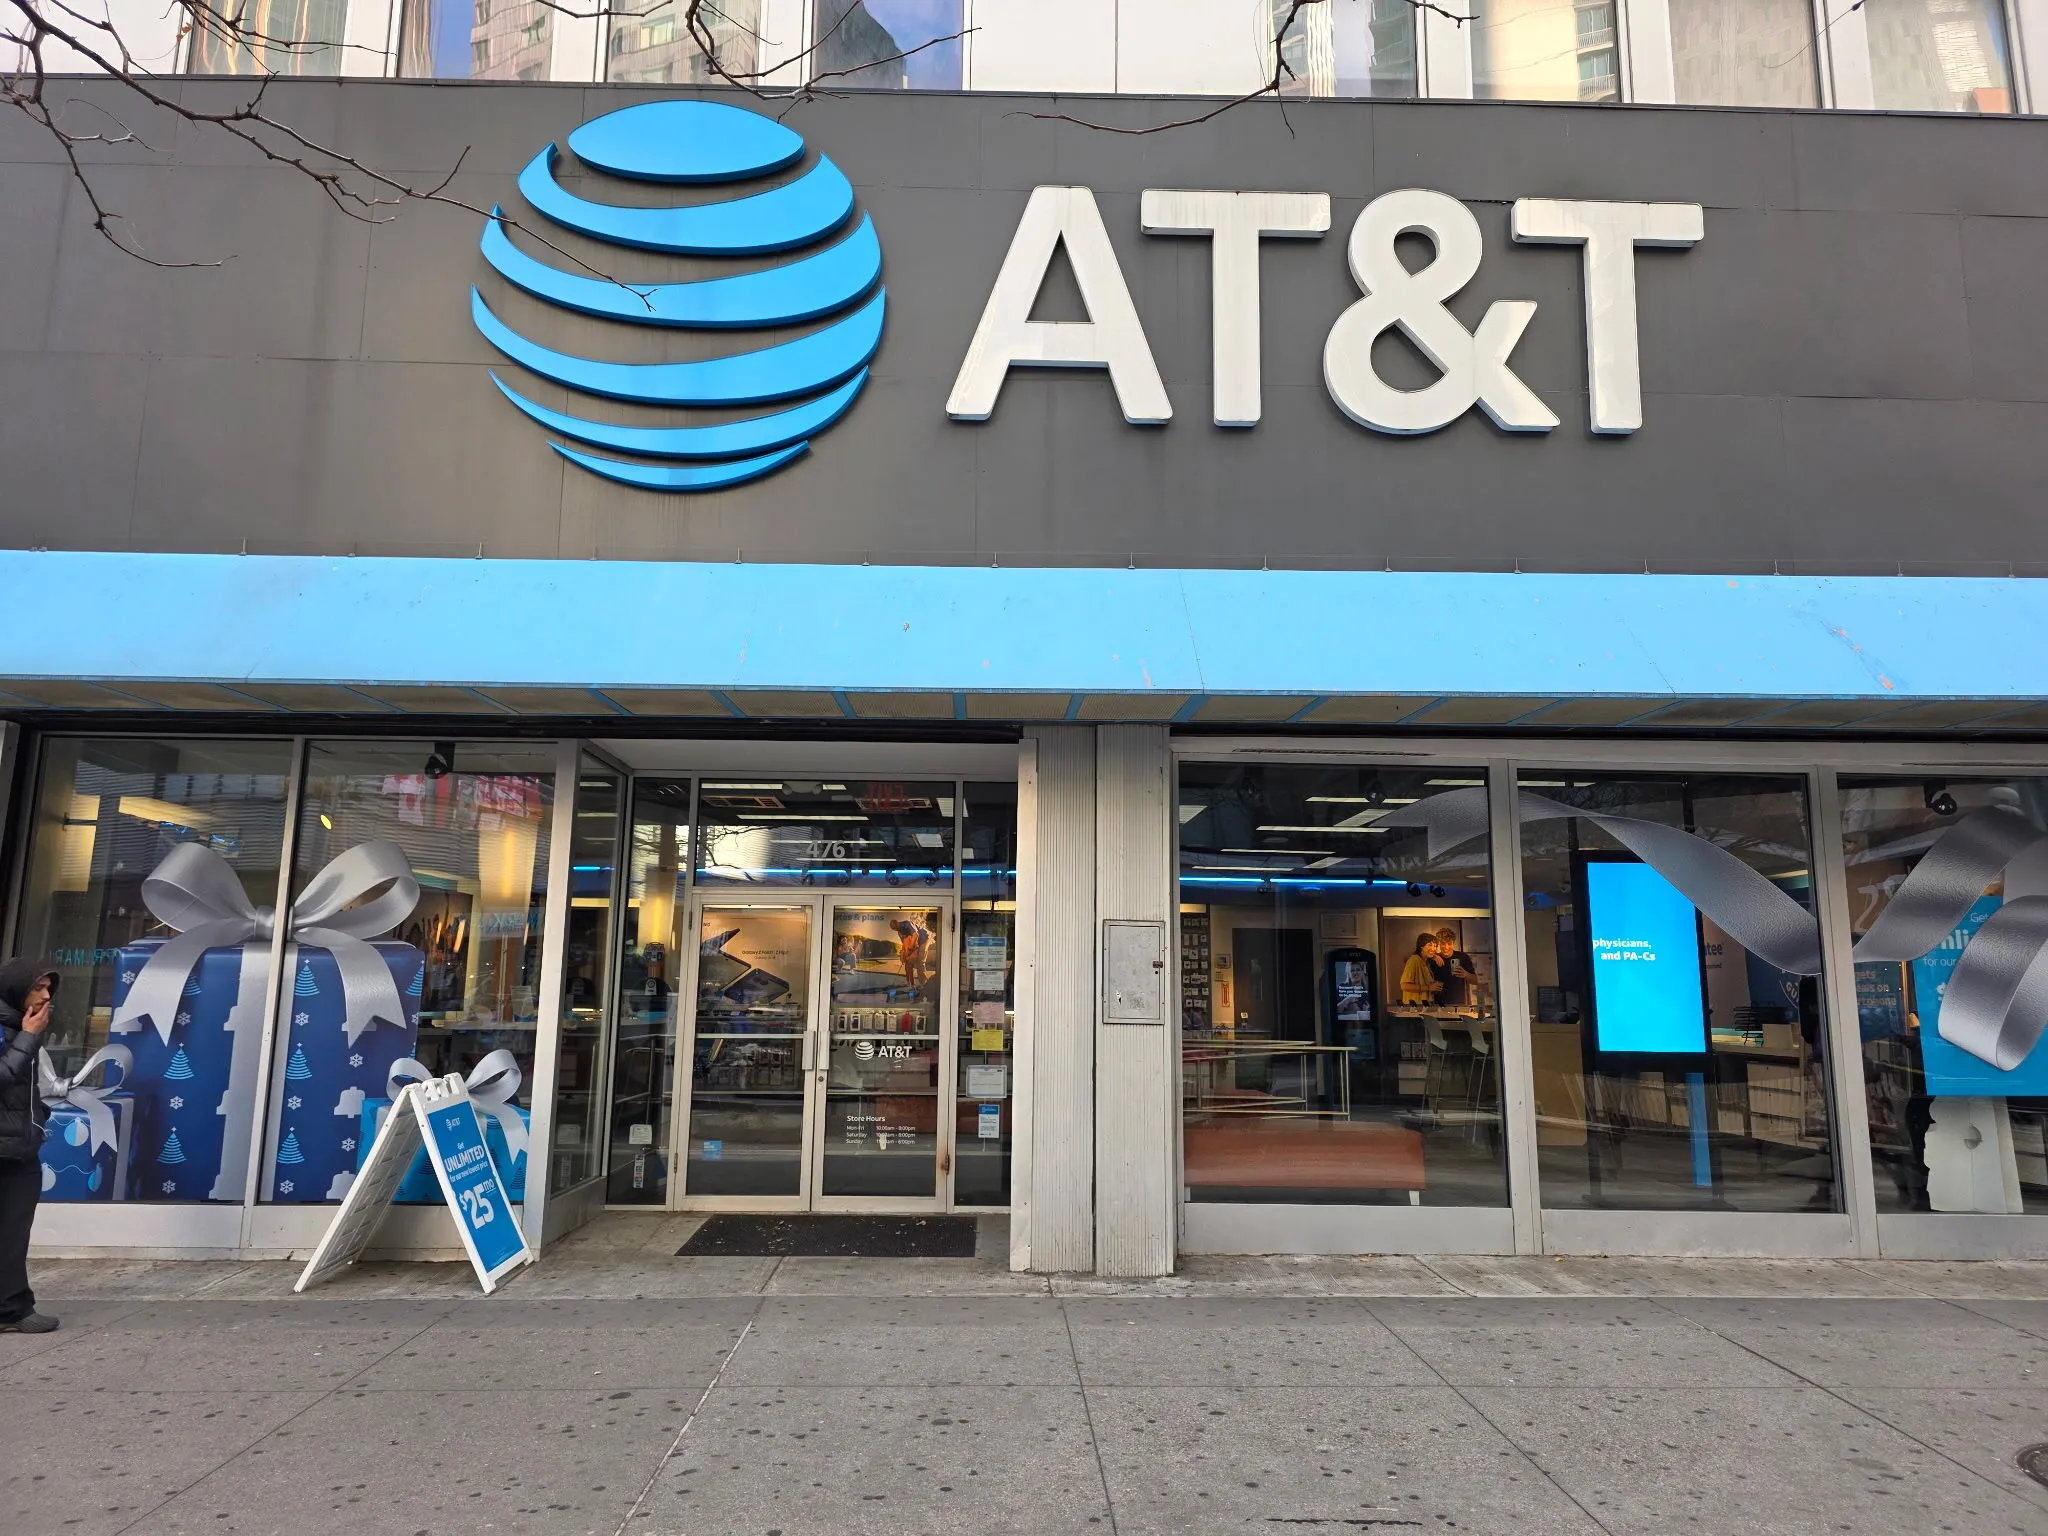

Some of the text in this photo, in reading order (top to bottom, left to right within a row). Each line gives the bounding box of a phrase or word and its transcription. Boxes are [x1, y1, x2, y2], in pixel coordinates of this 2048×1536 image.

[945, 184, 1705, 437] AT&T
[805, 839, 846, 858] 476
[862, 913, 885, 922] plans
[1970, 912, 1988, 922] Get
[1592, 938, 1652, 950] physicians,
[1941, 929, 1969, 950] nli
[1601, 951, 1656, 961] and PA-Cs
[1923, 956, 1957, 967] for our
[878, 1045, 913, 1058] AT&T
[444, 1145, 485, 1172] UNLIMITED
